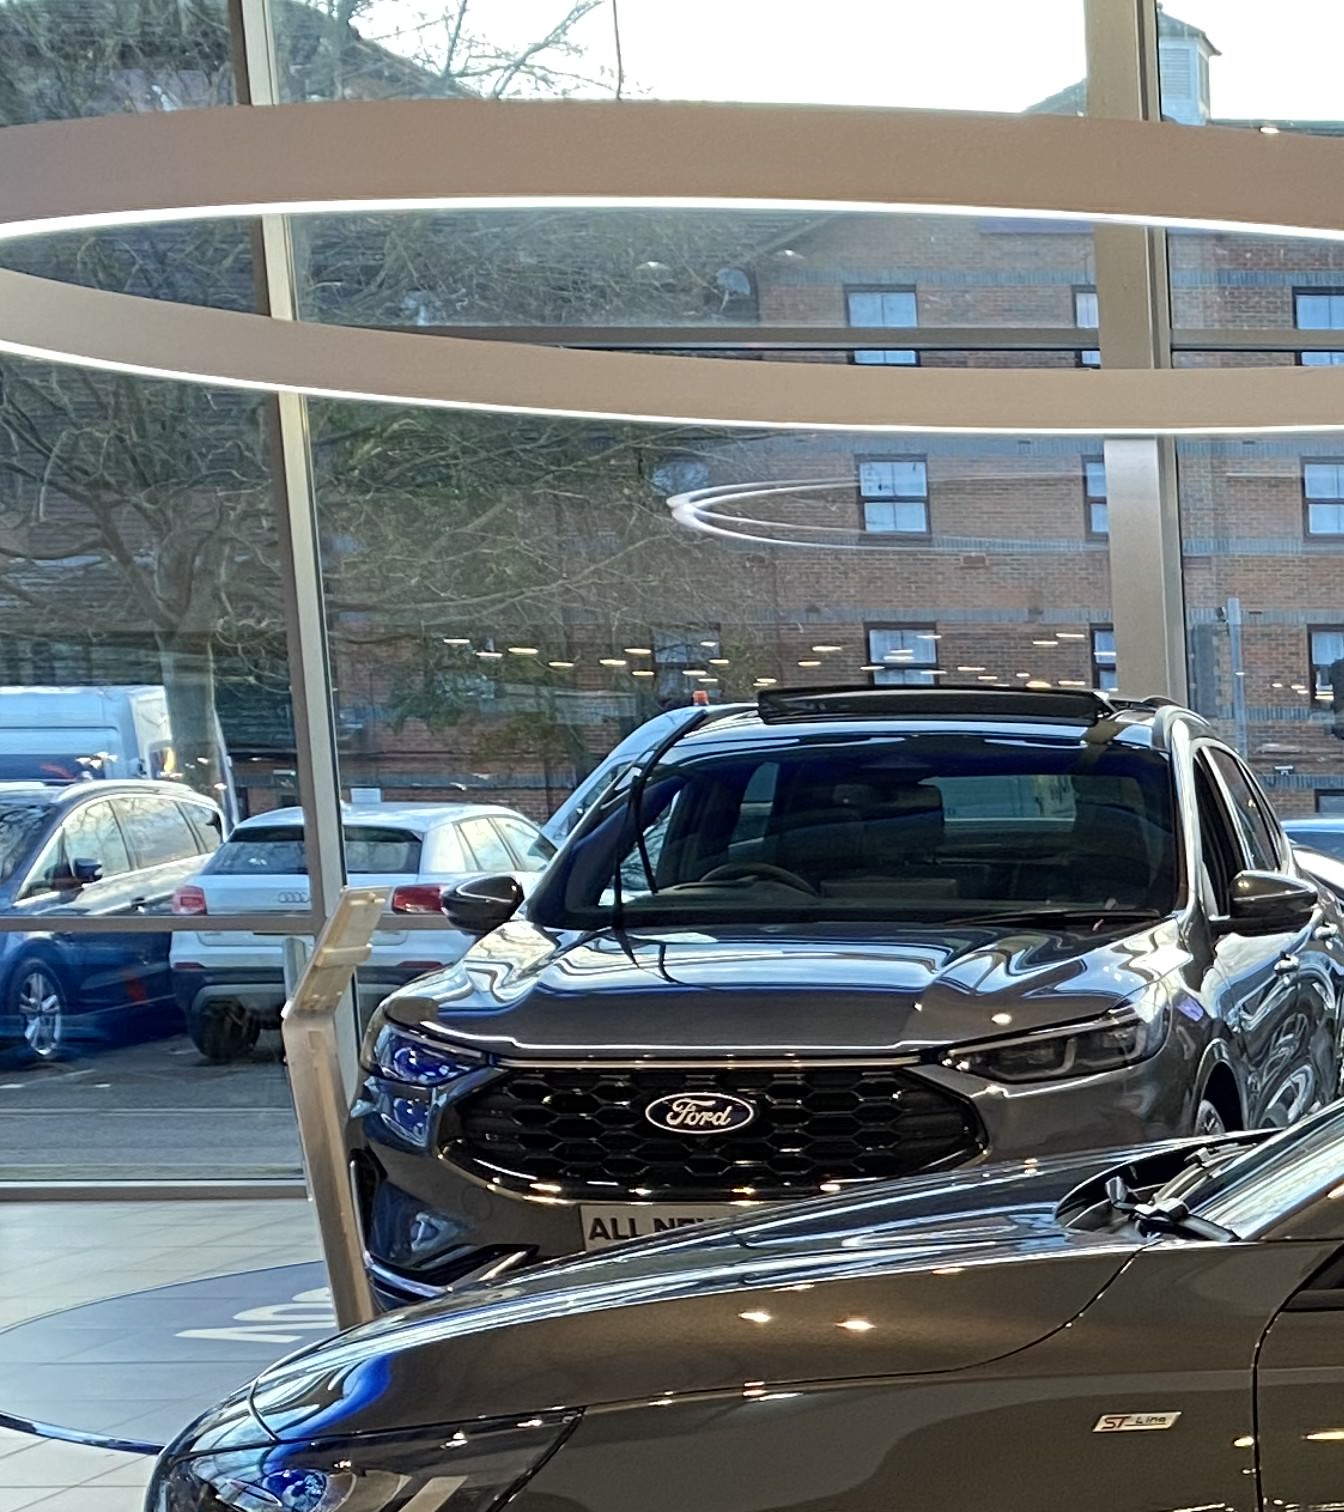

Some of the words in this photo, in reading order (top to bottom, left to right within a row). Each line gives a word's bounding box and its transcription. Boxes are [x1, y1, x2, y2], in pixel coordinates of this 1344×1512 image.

[666, 1098, 733, 1126] Ford
[588, 1217, 643, 1240] ALL
[1101, 1415, 1131, 1430] ST
